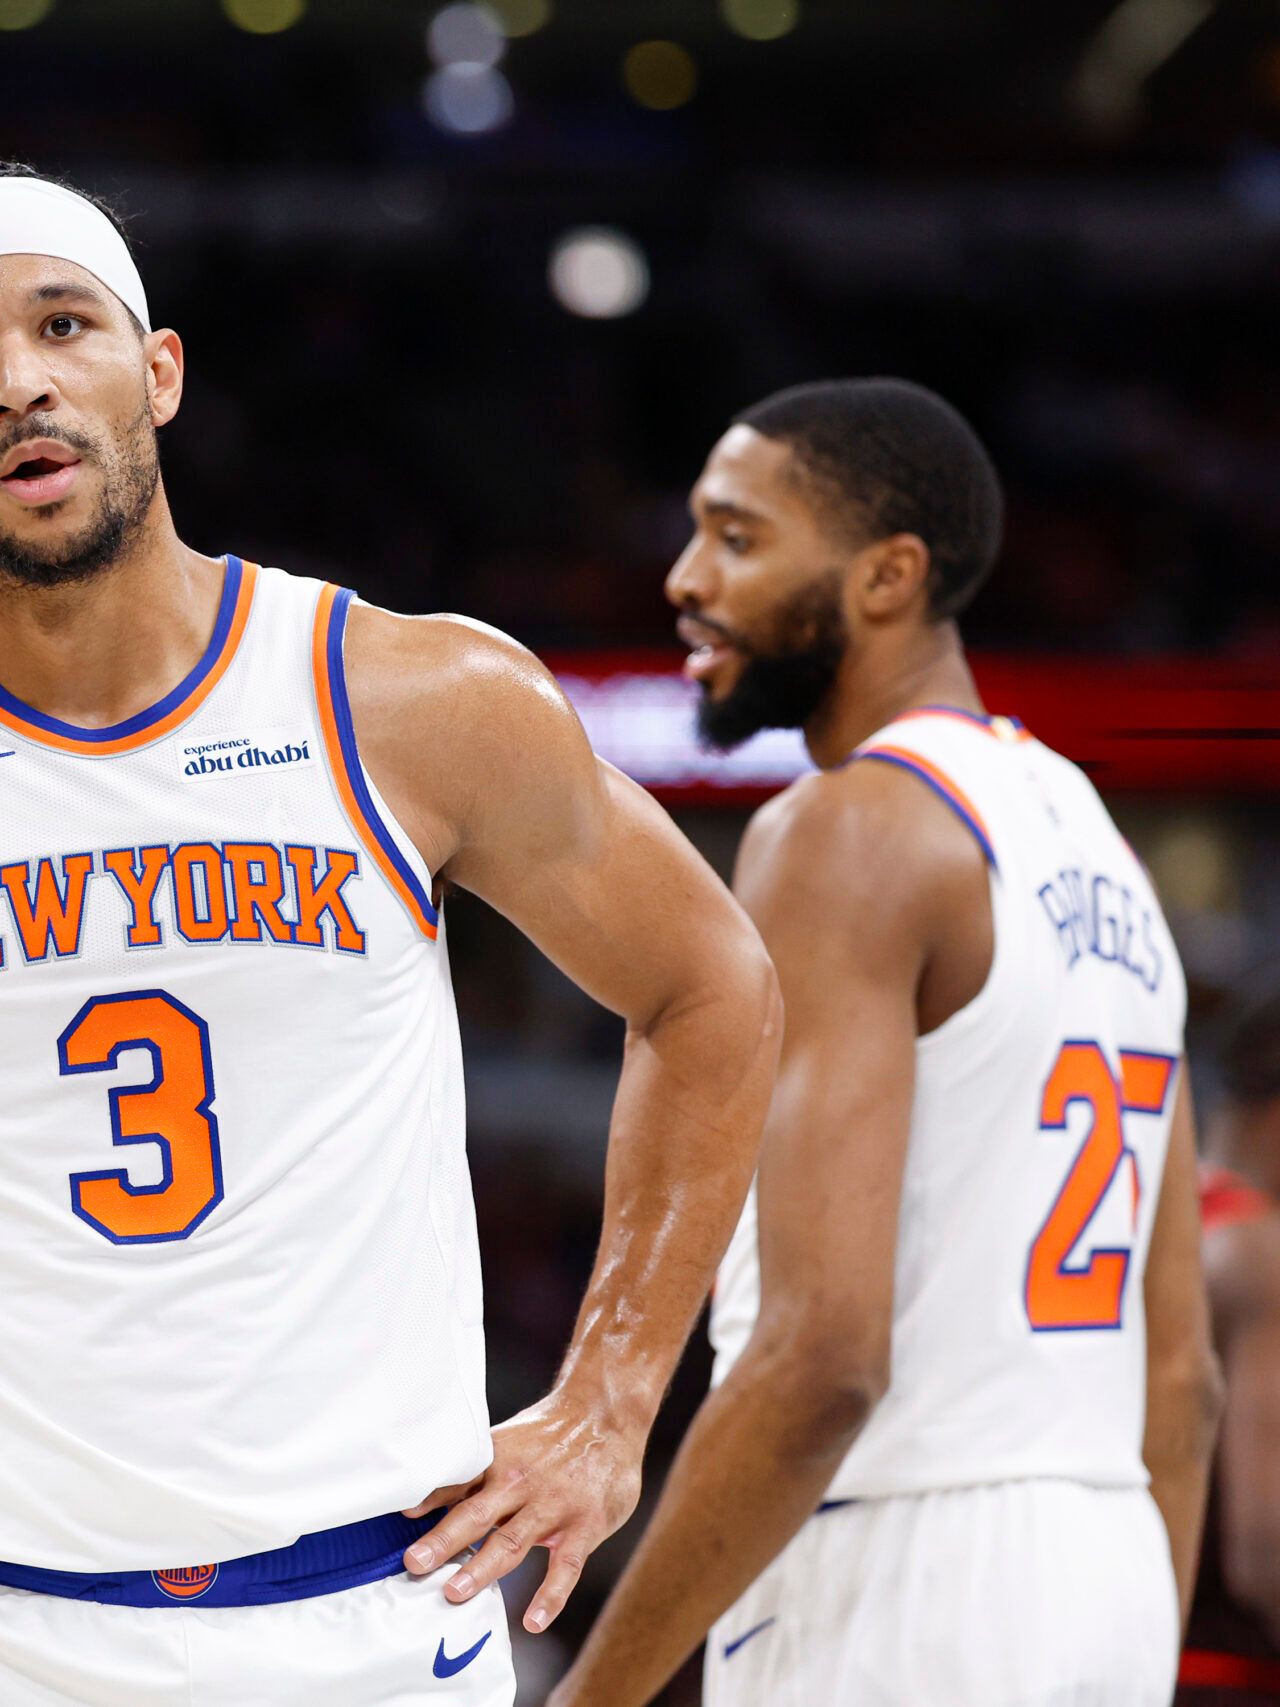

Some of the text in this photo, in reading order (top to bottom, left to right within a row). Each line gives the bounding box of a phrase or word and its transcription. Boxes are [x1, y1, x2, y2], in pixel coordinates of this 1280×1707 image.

[184, 738, 250, 756] experience
[184, 755, 233, 776] abu
[103, 842, 368, 957] YORK
[57, 989, 224, 1245] 3
[1024, 1040, 1178, 1332] 27
